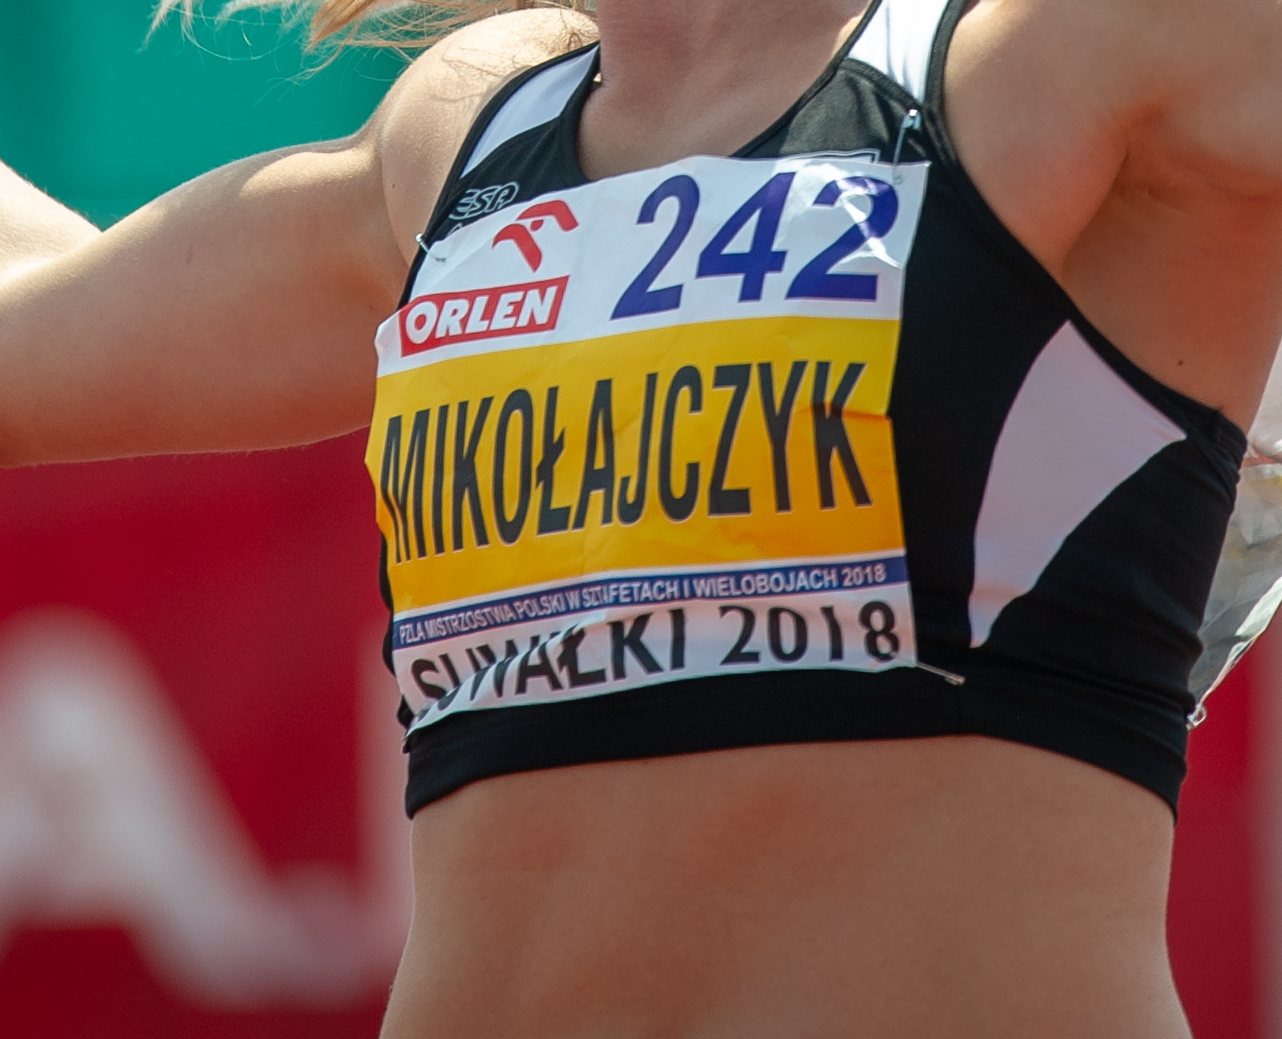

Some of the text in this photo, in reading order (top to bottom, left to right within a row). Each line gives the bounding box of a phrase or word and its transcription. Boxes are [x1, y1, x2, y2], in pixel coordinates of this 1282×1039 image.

[610, 171, 899, 321] 242
[405, 286, 559, 345] ORLEN
[380, 361, 873, 565] MIKOŁAJCZYK
[399, 622, 426, 646] PZLA
[425, 603, 514, 639] MISTRZOSTWA
[513, 590, 566, 621] POLSKI
[567, 588, 582, 611] W
[682, 579, 691, 598] I
[692, 568, 838, 598] WIELOBOJACH
[841, 563, 887, 587] 2018
[411, 600, 900, 723] SUWAŁKI 2018
